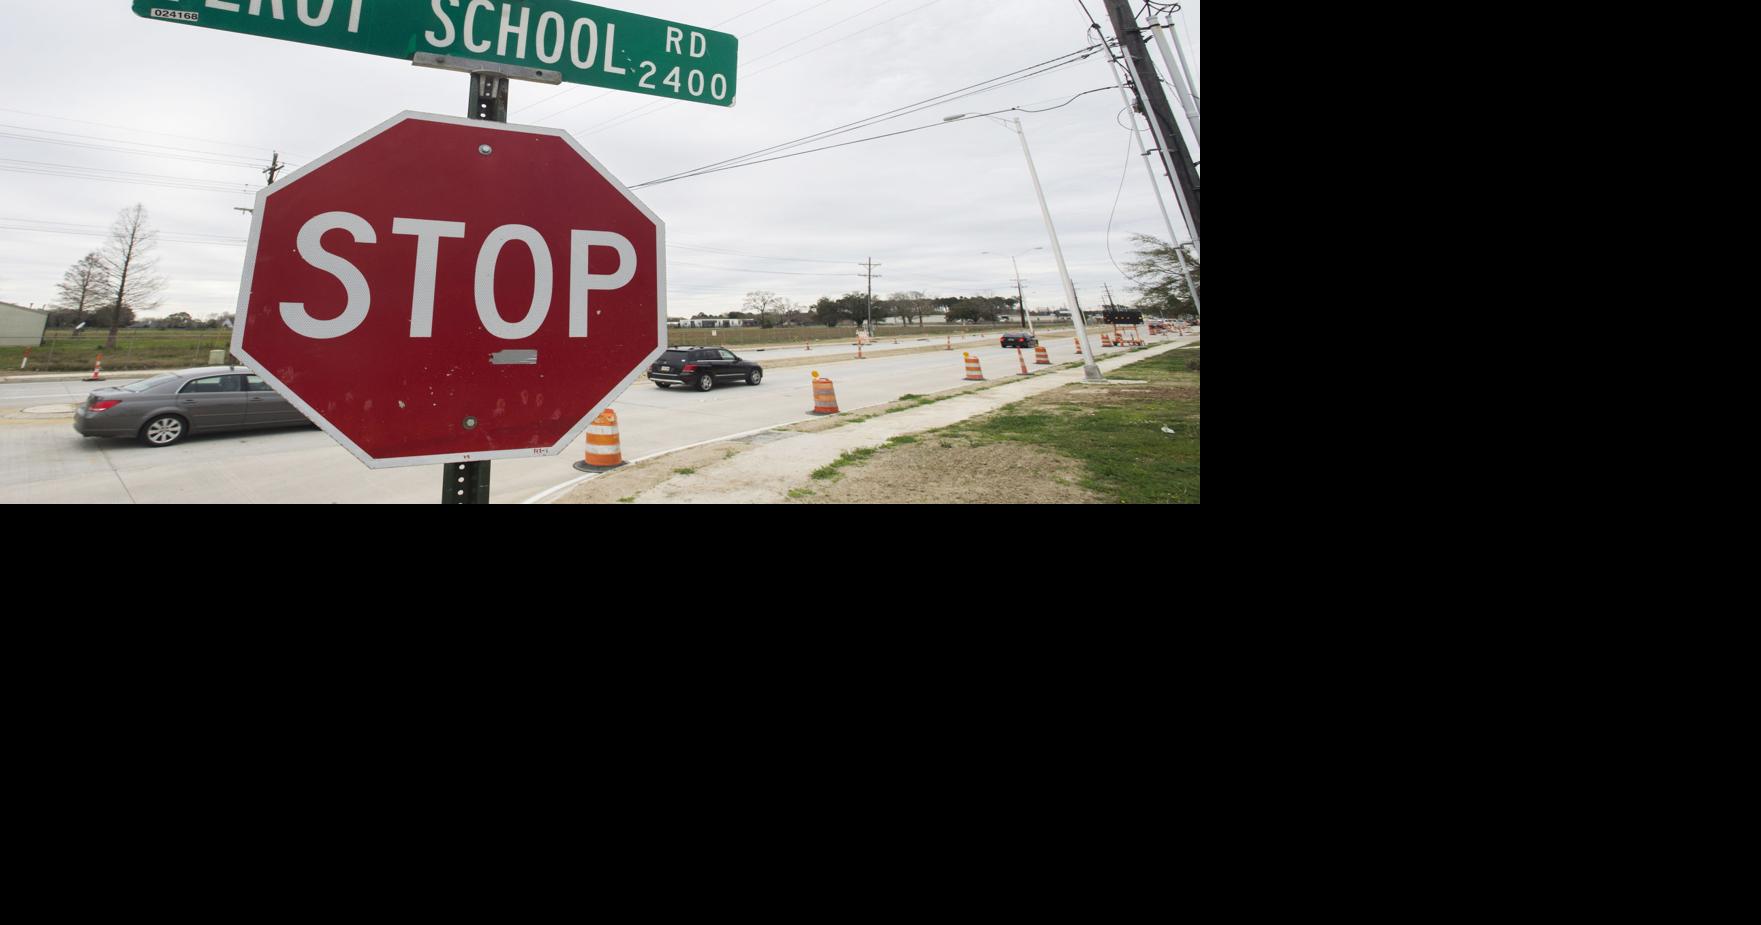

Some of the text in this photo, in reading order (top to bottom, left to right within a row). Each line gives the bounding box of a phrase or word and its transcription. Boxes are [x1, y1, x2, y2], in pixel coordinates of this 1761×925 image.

[154, 9, 198, 20] 024168
[425, 0, 626, 75] SCHOOL
[666, 26, 706, 58] RD
[639, 60, 727, 100] 2400
[279, 211, 637, 339] STOP
